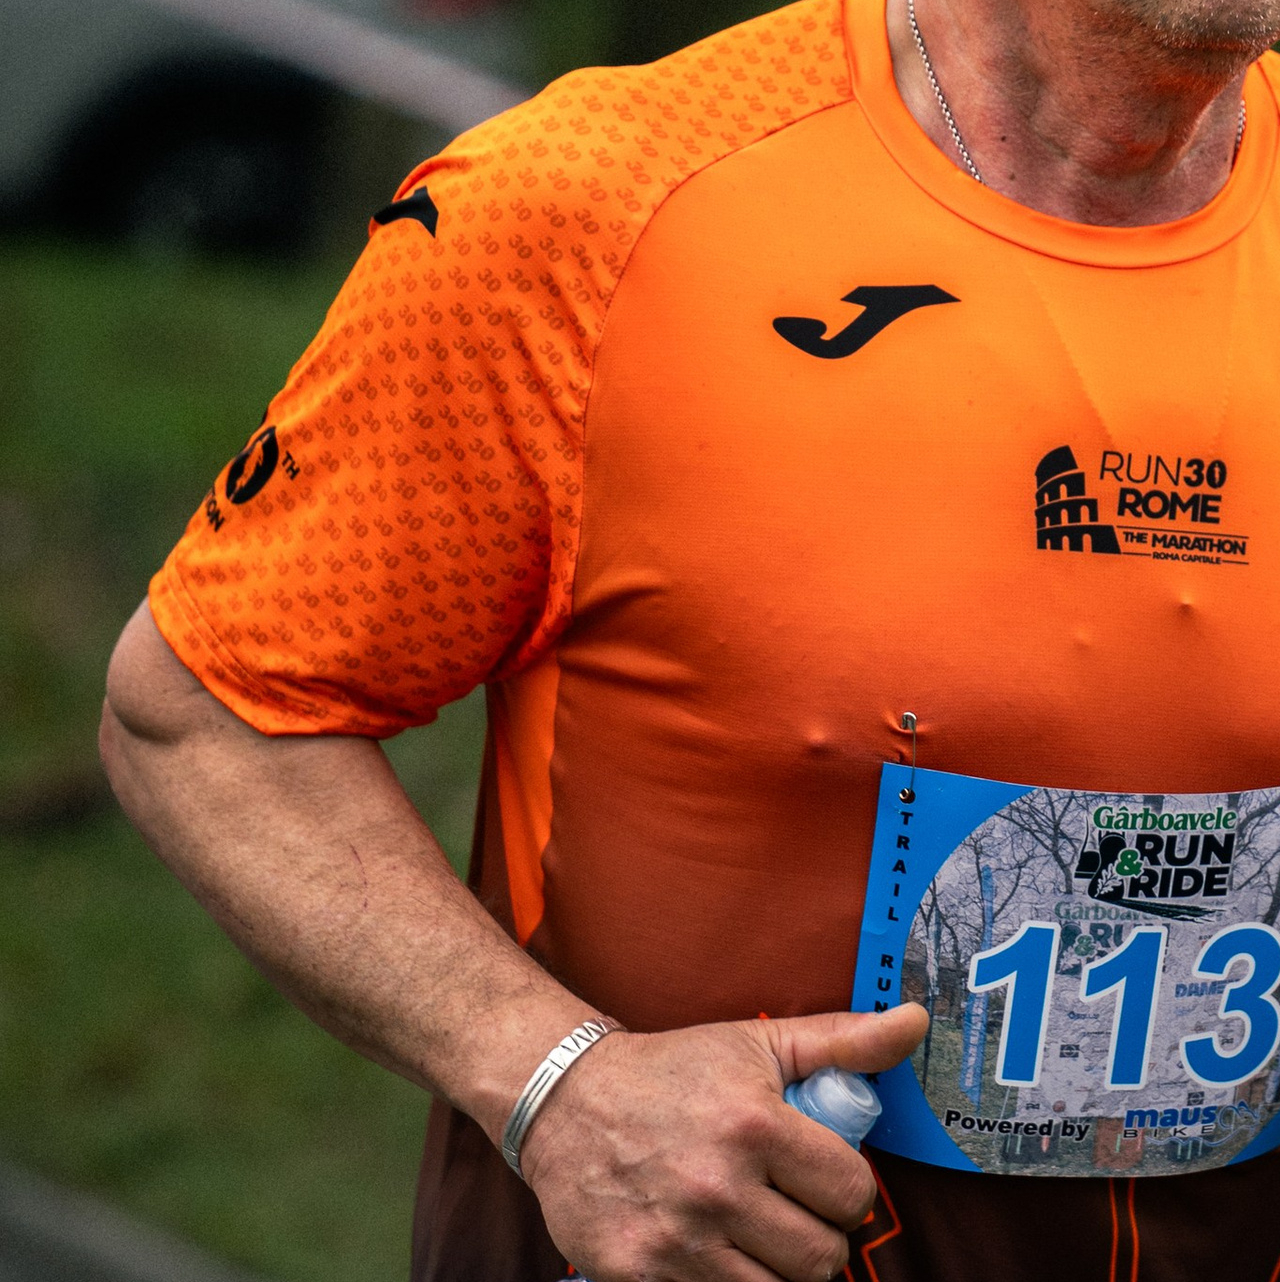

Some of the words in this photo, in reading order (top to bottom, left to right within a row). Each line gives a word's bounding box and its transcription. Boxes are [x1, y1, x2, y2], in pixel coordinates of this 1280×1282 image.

[281, 450, 301, 482] TH
[1117, 487, 1222, 525] ROME
[1123, 531, 1148, 544] THE
[1151, 533, 1247, 556] MARATHON
[1152, 551, 1180, 562] ROMA
[1181, 553, 1222, 565] CAPITALE
[1093, 805, 1237, 832] Gârboavele
[1115, 849, 1143, 877] &
[1136, 833, 1236, 867] RUN
[887, 811, 913, 922] TRAIL
[1128, 867, 1231, 899] RIDE
[1175, 979, 1240, 998] DAME
[944, 1109, 1054, 1138] Powered
[1061, 1120, 1090, 1141] by
[1124, 1103, 1218, 1129] maus
[1123, 1124, 1217, 1138] BIKE
